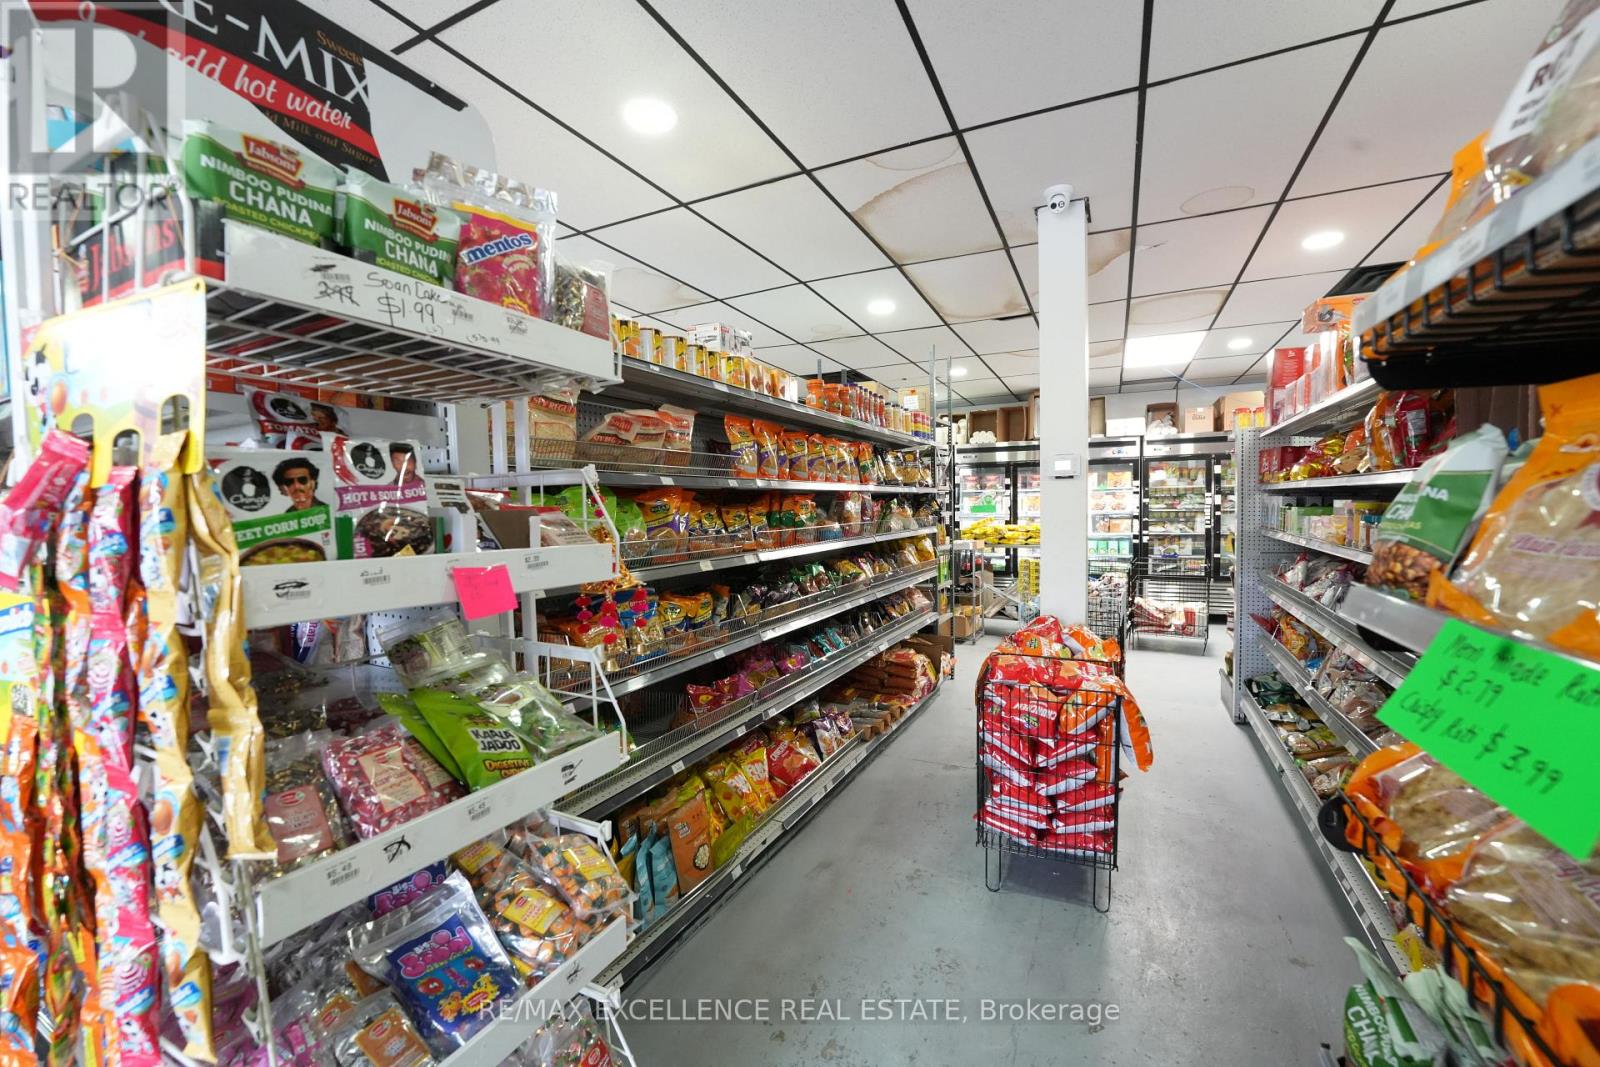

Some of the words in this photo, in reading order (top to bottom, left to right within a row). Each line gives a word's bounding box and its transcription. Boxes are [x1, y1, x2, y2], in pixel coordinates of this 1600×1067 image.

[160, 0, 370, 112] E-MIX
[234, 64, 277, 103] hot
[287, 92, 352, 129] water
[200, 154, 272, 191] NIMBOO
[276, 186, 333, 216] PUDINA
[229, 180, 314, 227] CHANA
[364, 218, 412, 247] NIMBOO
[385, 240, 438, 277] CHANA
[466, 233, 532, 263] mentos
[267, 422, 319, 436] TOMATO
[343, 490, 367, 505] HOT
[264, 519, 299, 536] CORN
[301, 513, 327, 530] SOUP
[480, 740, 520, 751] JADOO
